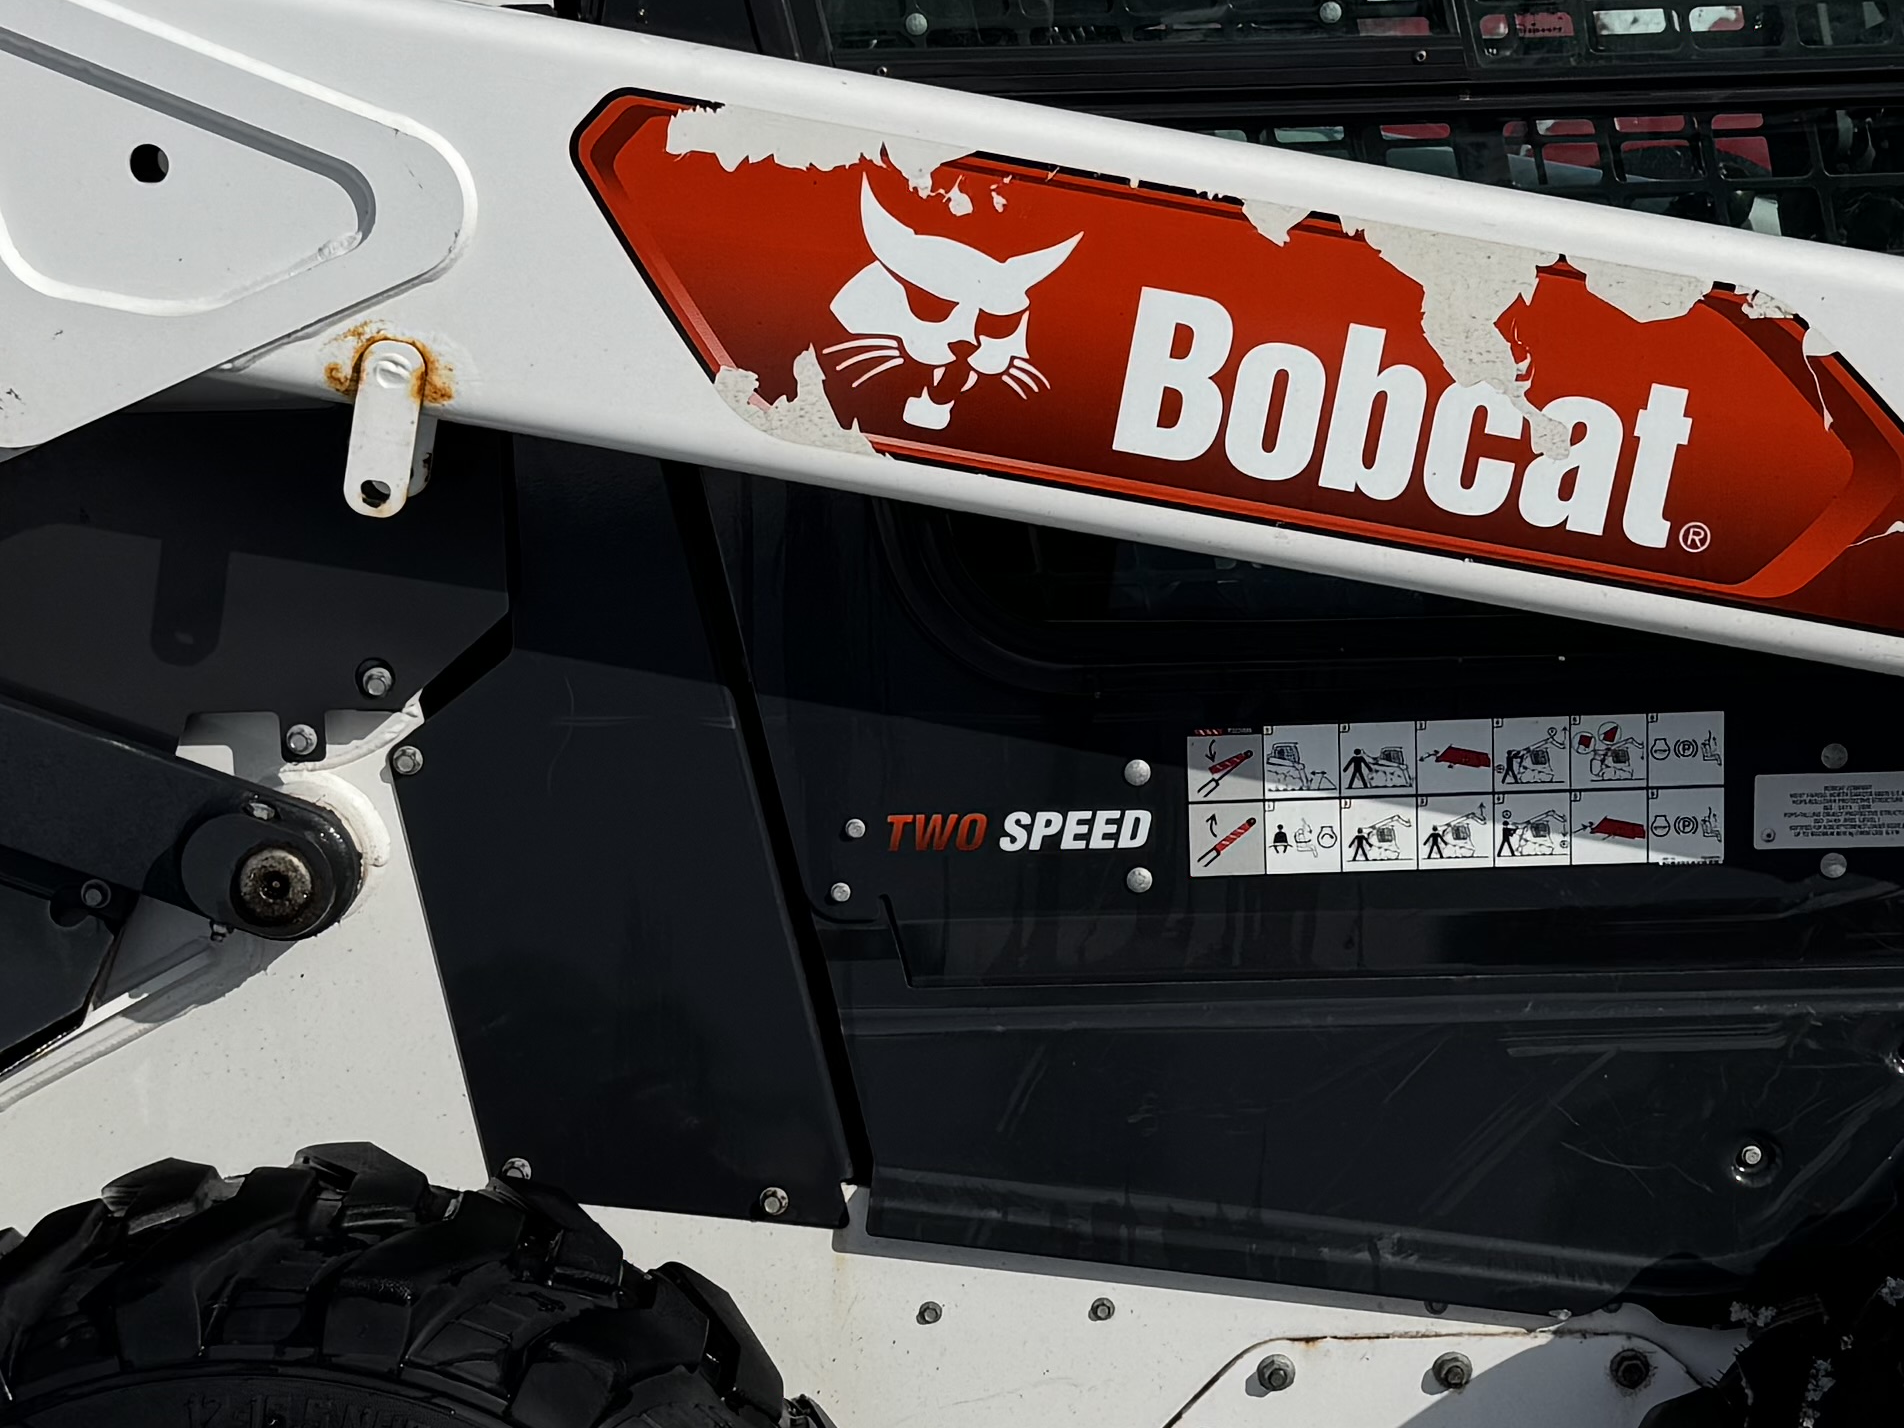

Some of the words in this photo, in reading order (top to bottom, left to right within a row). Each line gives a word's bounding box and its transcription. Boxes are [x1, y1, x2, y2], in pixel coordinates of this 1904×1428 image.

[1112, 284, 1693, 550] Bobcat
[887, 812, 988, 852] TWO
[999, 809, 1152, 852] SPEED
